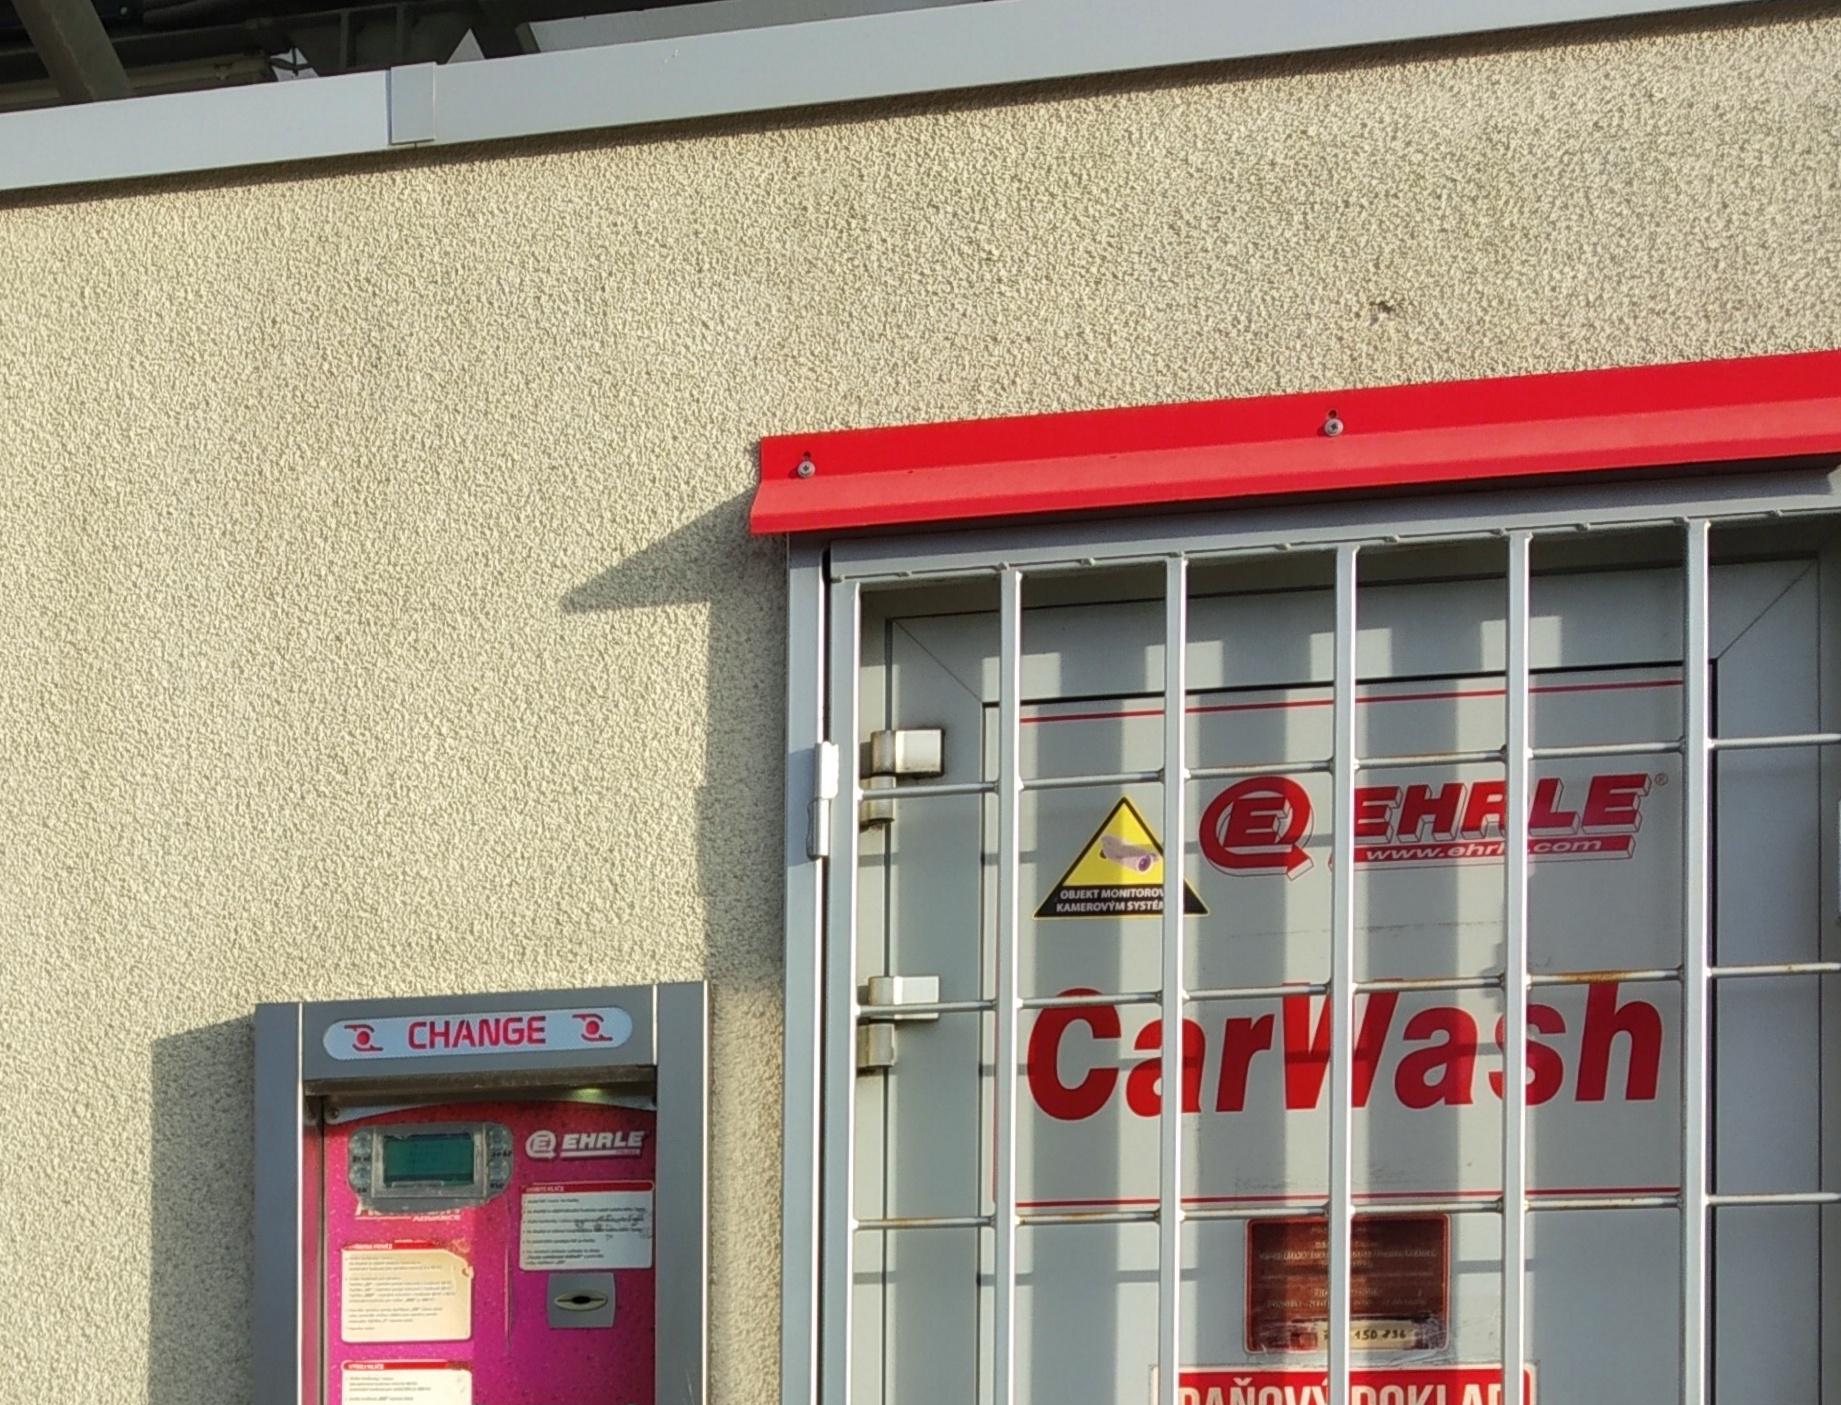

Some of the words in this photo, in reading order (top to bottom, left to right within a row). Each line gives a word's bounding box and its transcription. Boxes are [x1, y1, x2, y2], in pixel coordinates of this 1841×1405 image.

[1354, 773, 1652, 844] EHRLE
[1366, 837, 1602, 862] www.ehrl.com
[1060, 889, 1098, 899] OBJEKT
[1101, 887, 1164, 898] MONITOROV
[1056, 900, 1125, 912] KAMEROVÝM
[408, 1015, 546, 1049] CHANGE
[1027, 977, 1664, 1121] CarWash
[561, 1131, 645, 1149] EHRLE
